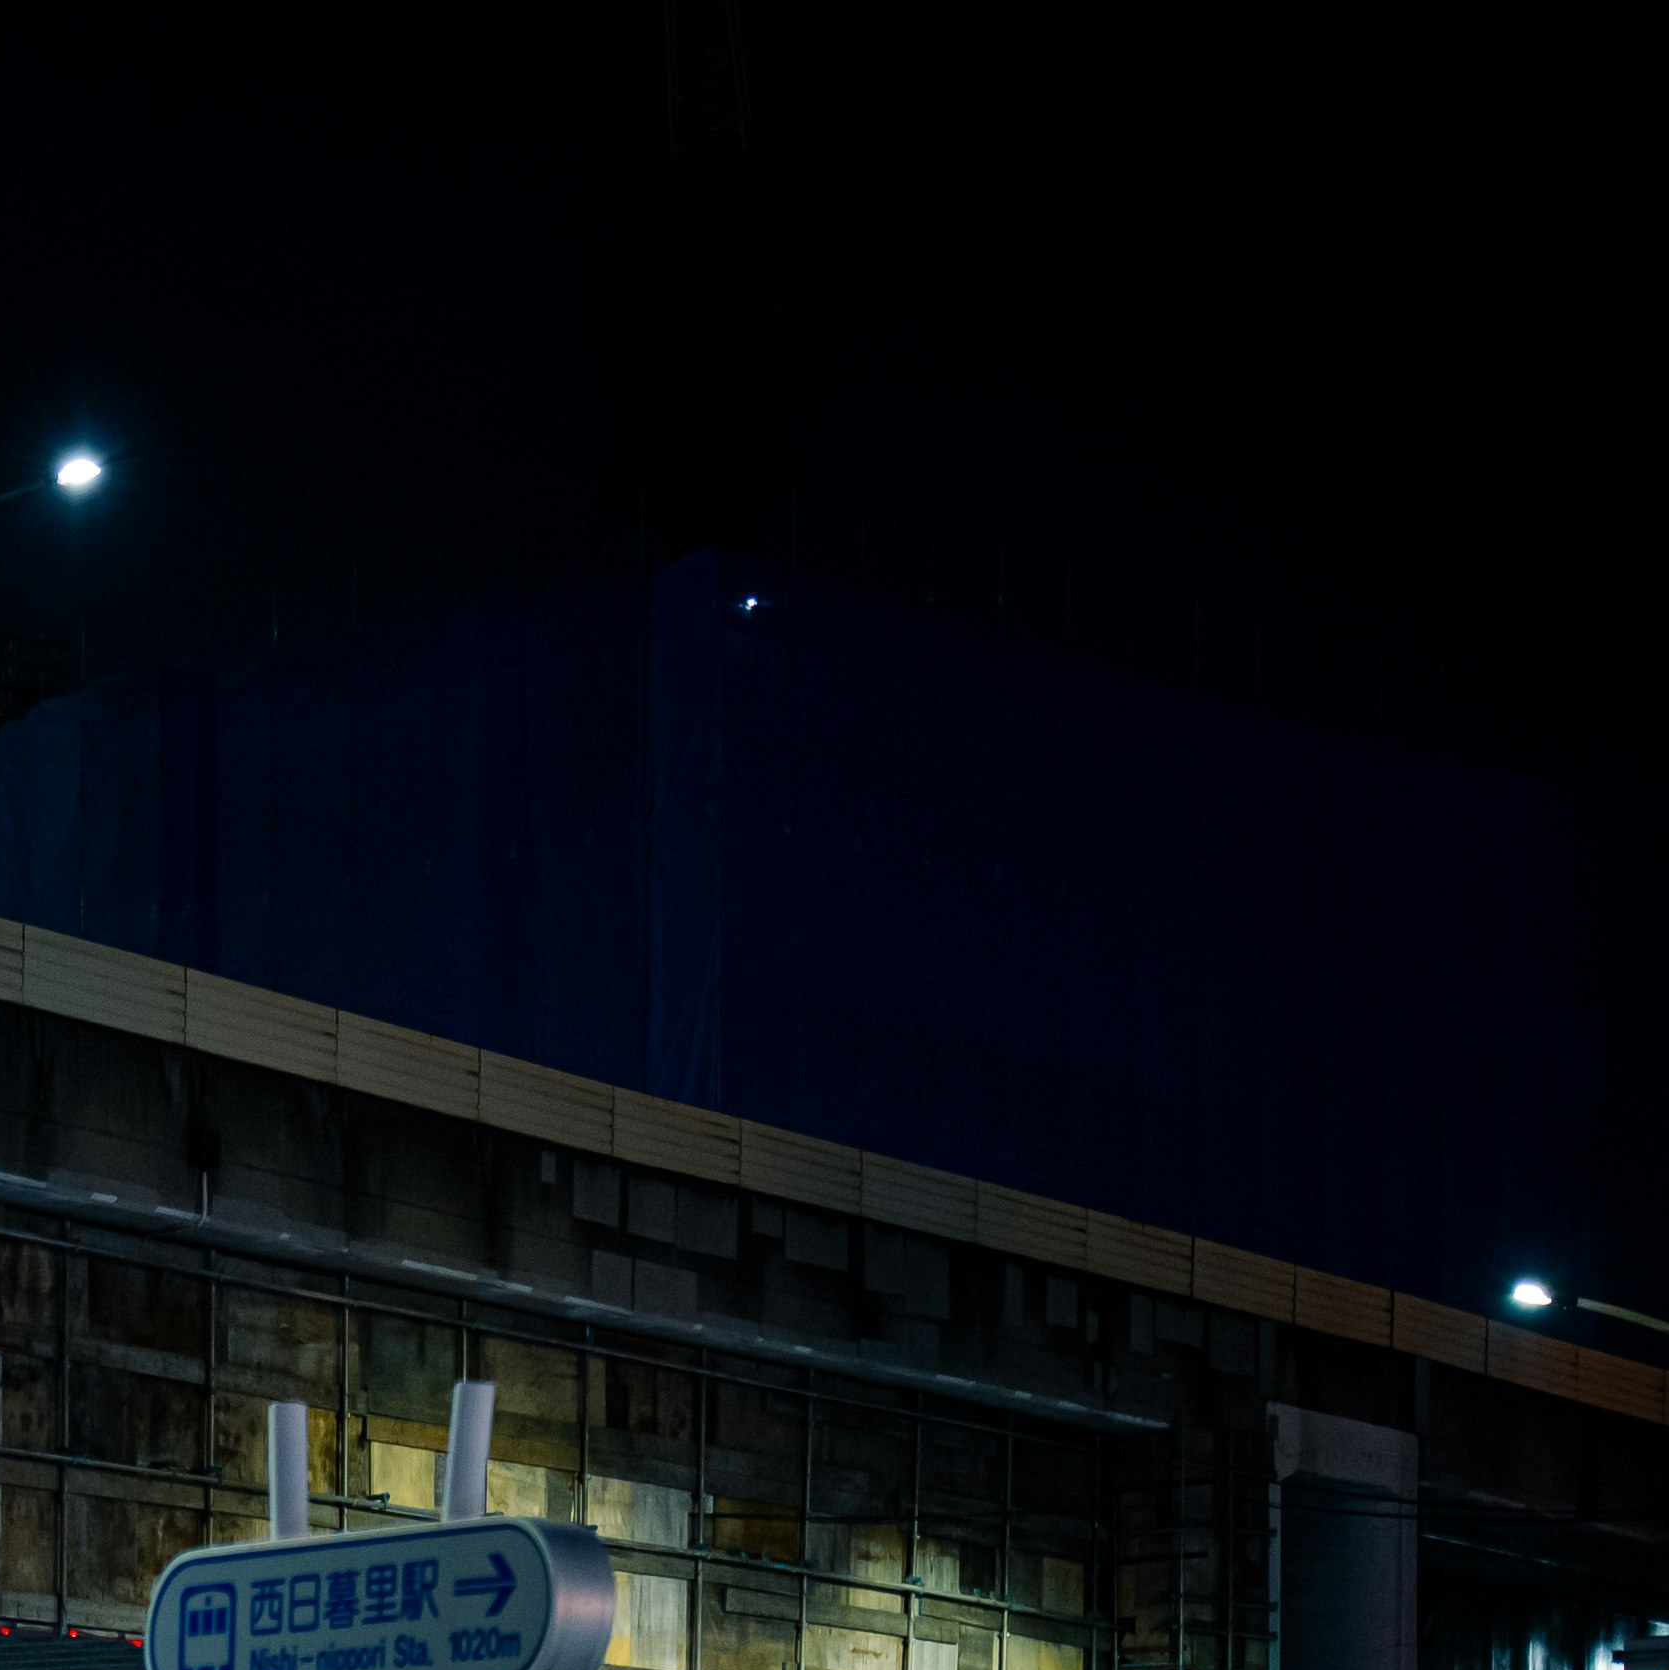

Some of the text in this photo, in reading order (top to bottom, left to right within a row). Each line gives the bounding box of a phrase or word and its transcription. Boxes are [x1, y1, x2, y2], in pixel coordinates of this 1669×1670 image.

[249, 1558, 439, 1636] 西日暮里駅
[393, 1633, 433, 1668] Sta.
[449, 1626, 522, 1663] 1020m
